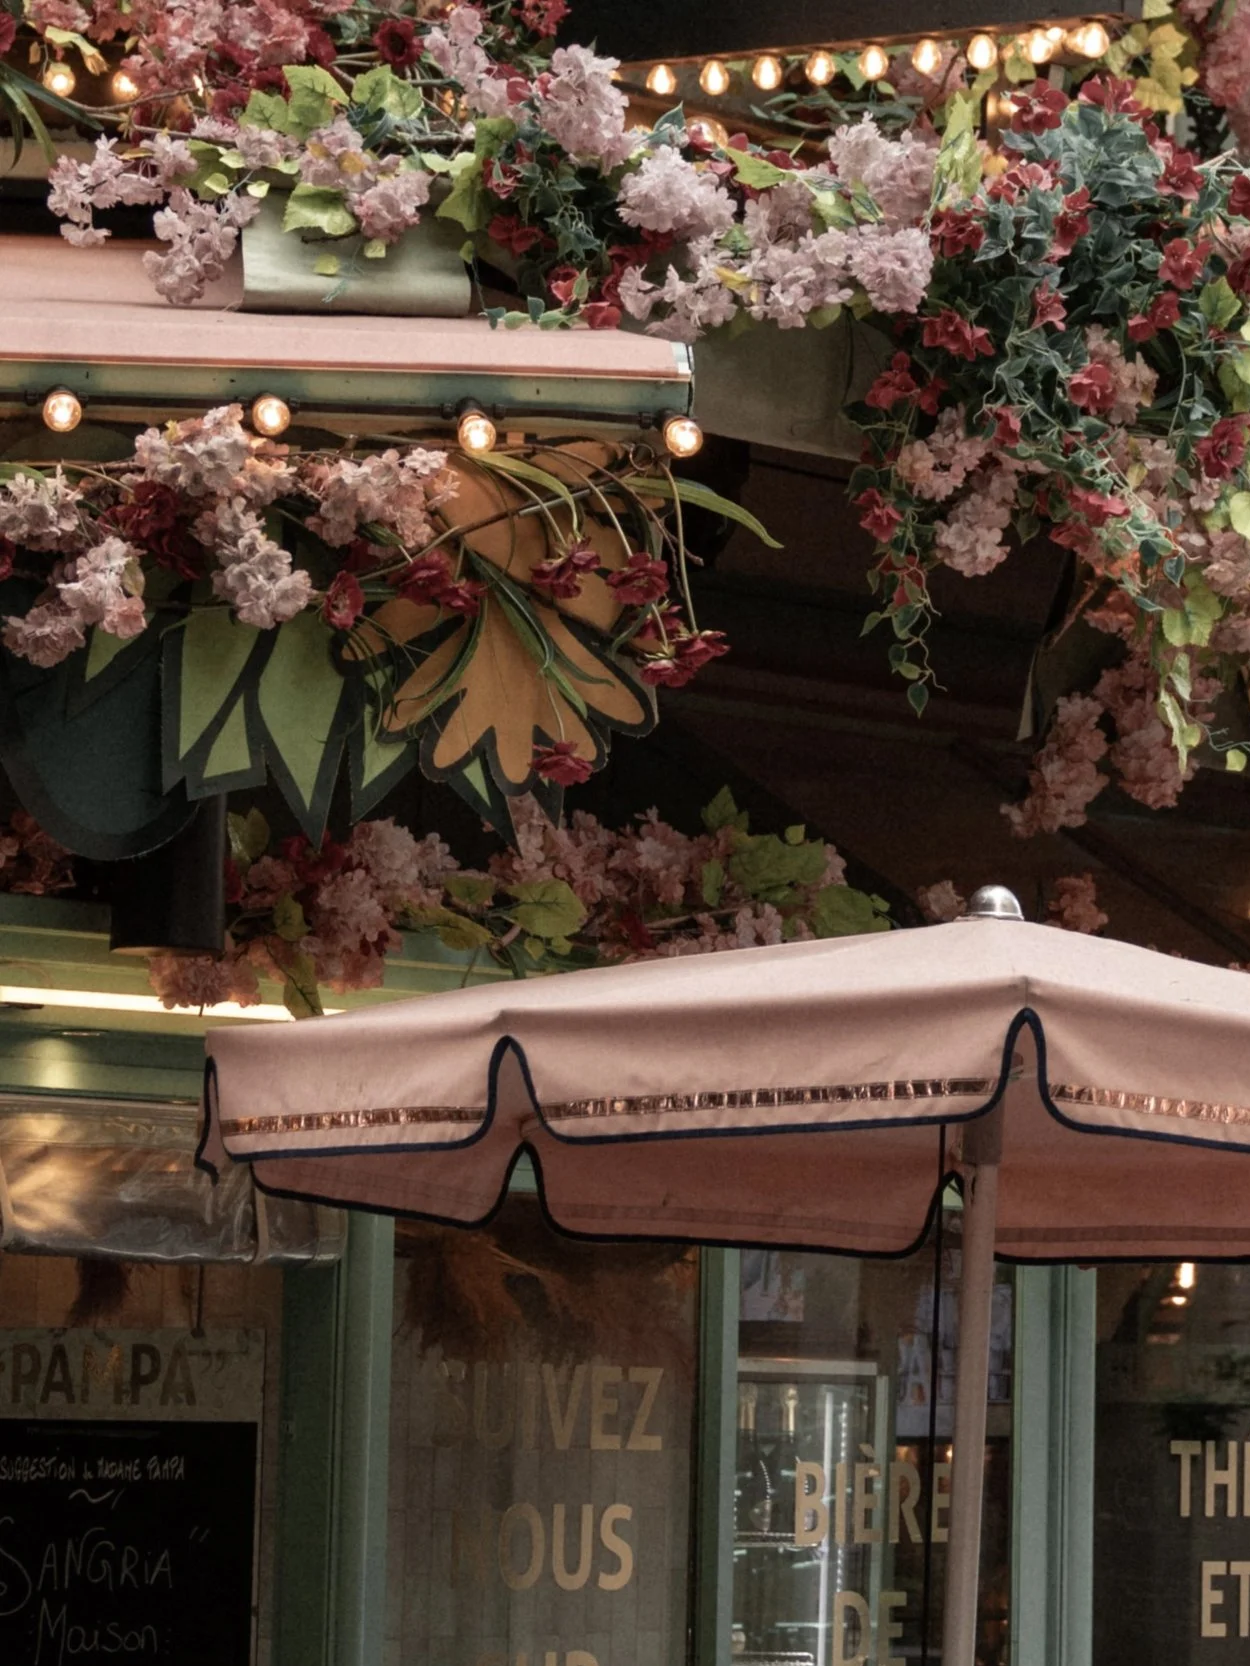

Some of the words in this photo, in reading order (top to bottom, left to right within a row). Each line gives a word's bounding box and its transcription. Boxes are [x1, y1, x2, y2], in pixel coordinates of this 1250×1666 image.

[431, 1362, 664, 1452] SUIVEZ
[794, 1443, 953, 1547] BIÈRE
[451, 1501, 635, 1592] NOUS
